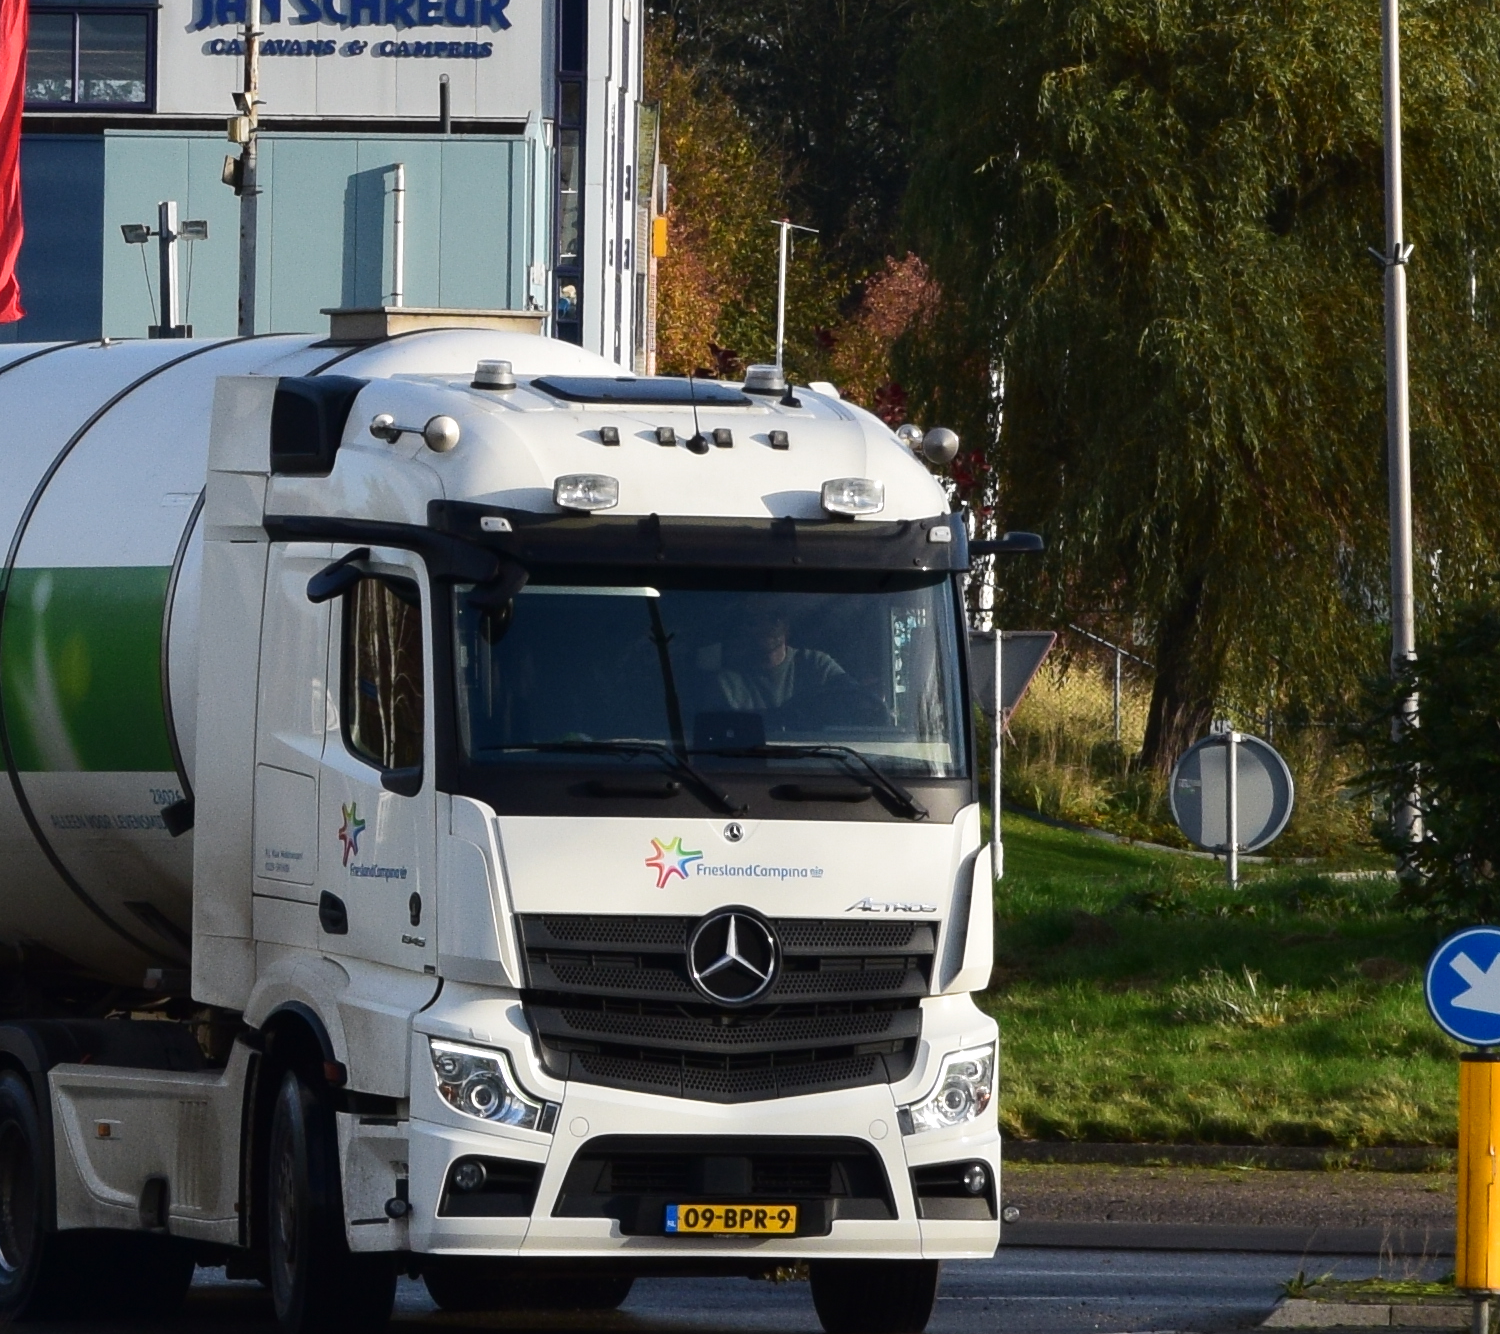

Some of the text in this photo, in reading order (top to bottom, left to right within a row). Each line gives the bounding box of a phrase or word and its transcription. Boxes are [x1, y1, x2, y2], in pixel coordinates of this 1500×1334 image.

[210, 38, 494, 58] CAAVANS & CAMPERS
[696, 863, 808, 882] FrieslandCampina
[683, 1207, 792, 1229] 09-BPR-9
